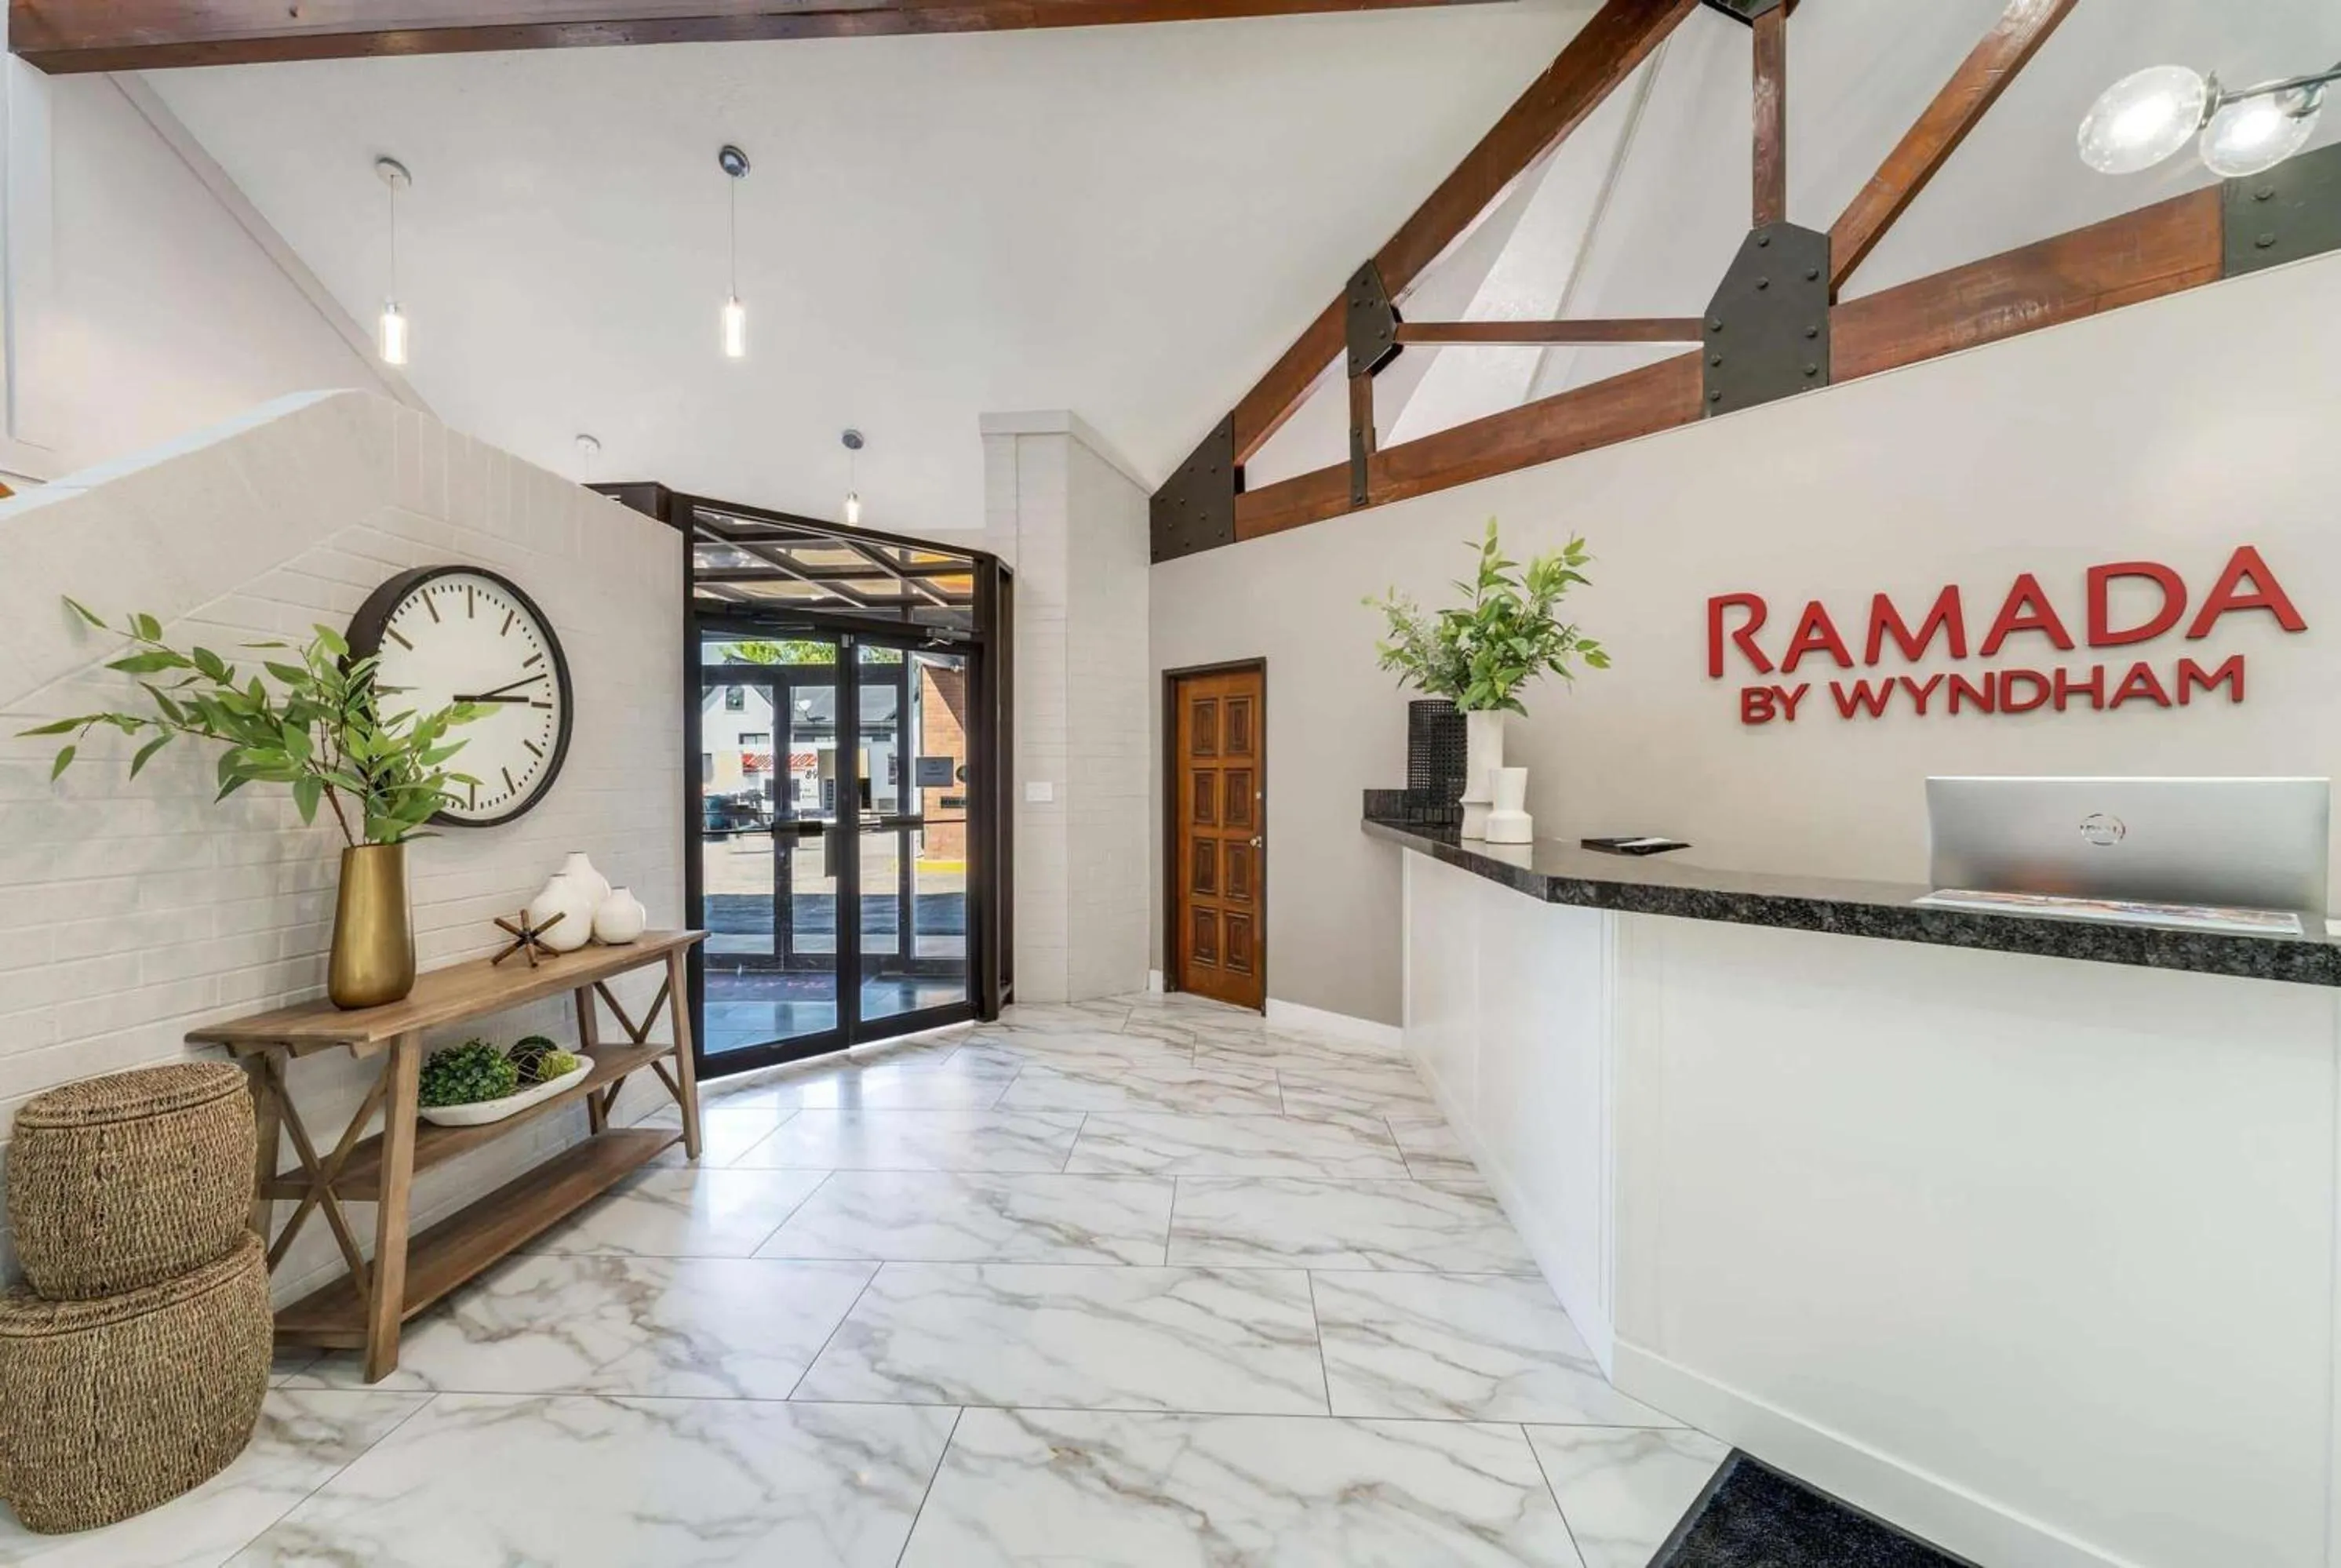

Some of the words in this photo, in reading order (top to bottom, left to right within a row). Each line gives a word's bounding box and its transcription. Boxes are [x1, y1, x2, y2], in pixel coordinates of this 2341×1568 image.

[1707, 545, 2307, 678] RAMADA
[1740, 682, 1810, 725] BY
[1829, 653, 2245, 719] WYNDHAM
